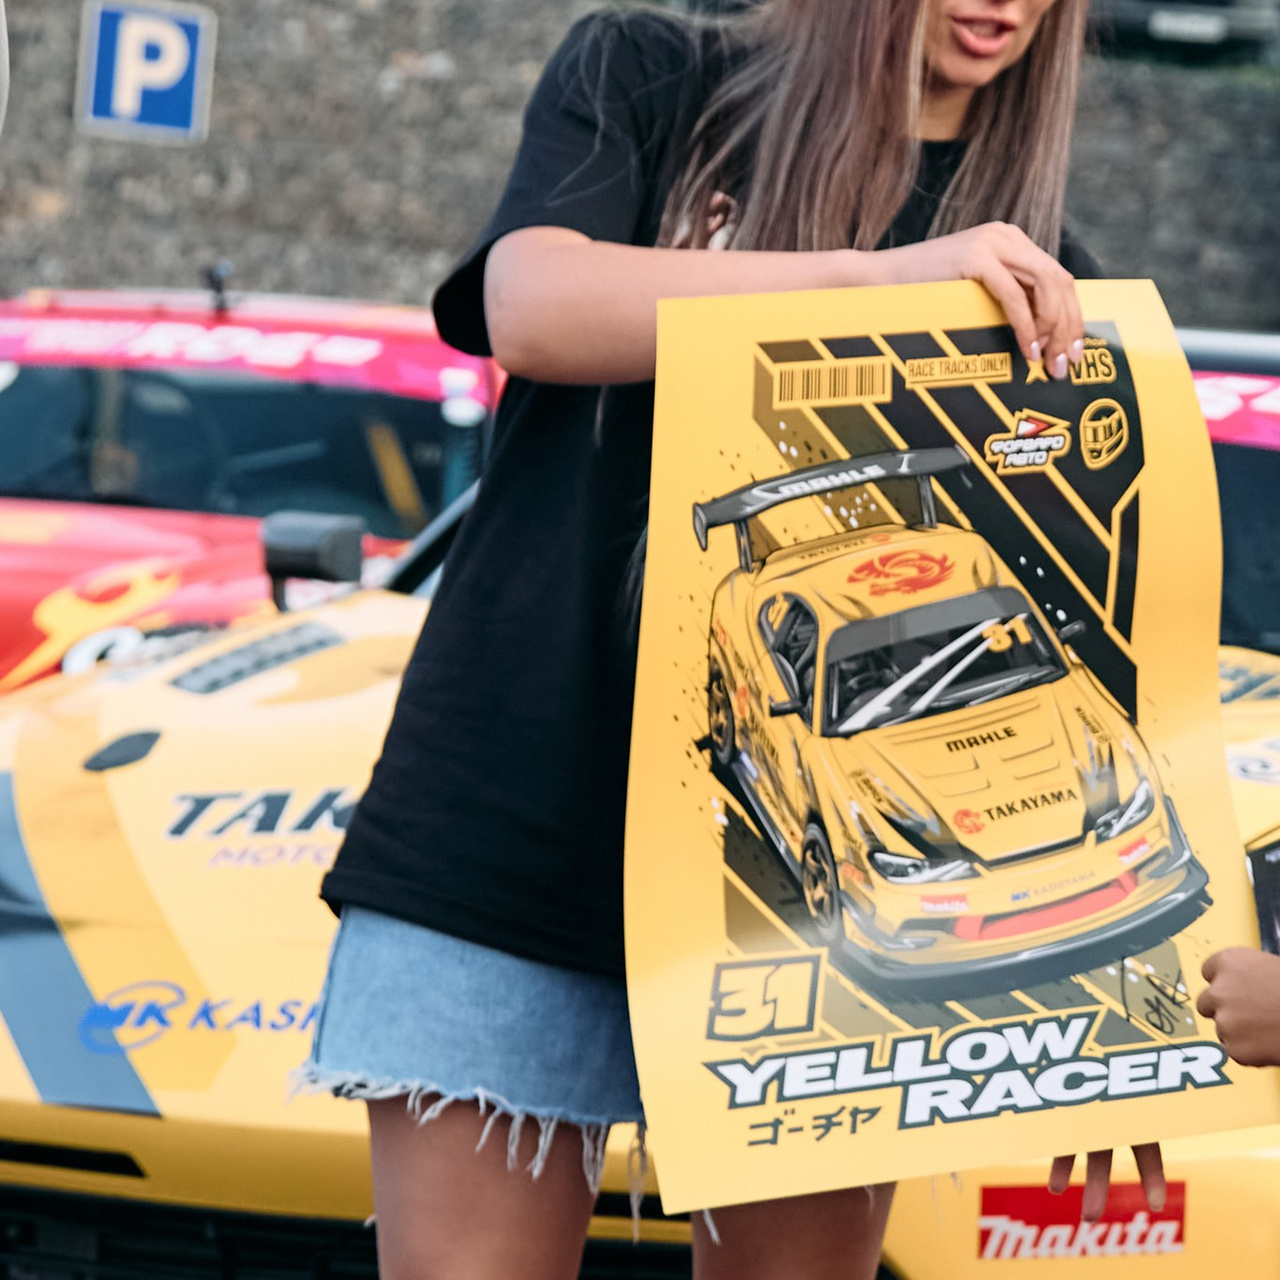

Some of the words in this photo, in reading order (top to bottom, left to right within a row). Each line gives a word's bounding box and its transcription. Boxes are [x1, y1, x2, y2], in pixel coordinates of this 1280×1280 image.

[111, 15, 191, 120] P
[908, 360, 935, 379] RACE
[939, 356, 979, 376] TRACKS
[945, 726, 1018, 753] MAHLE
[983, 788, 1078, 822] TAKAYAMA
[711, 957, 816, 1039] 31
[716, 1016, 1096, 1105] YELLOW
[904, 1044, 1230, 1125] RACER
